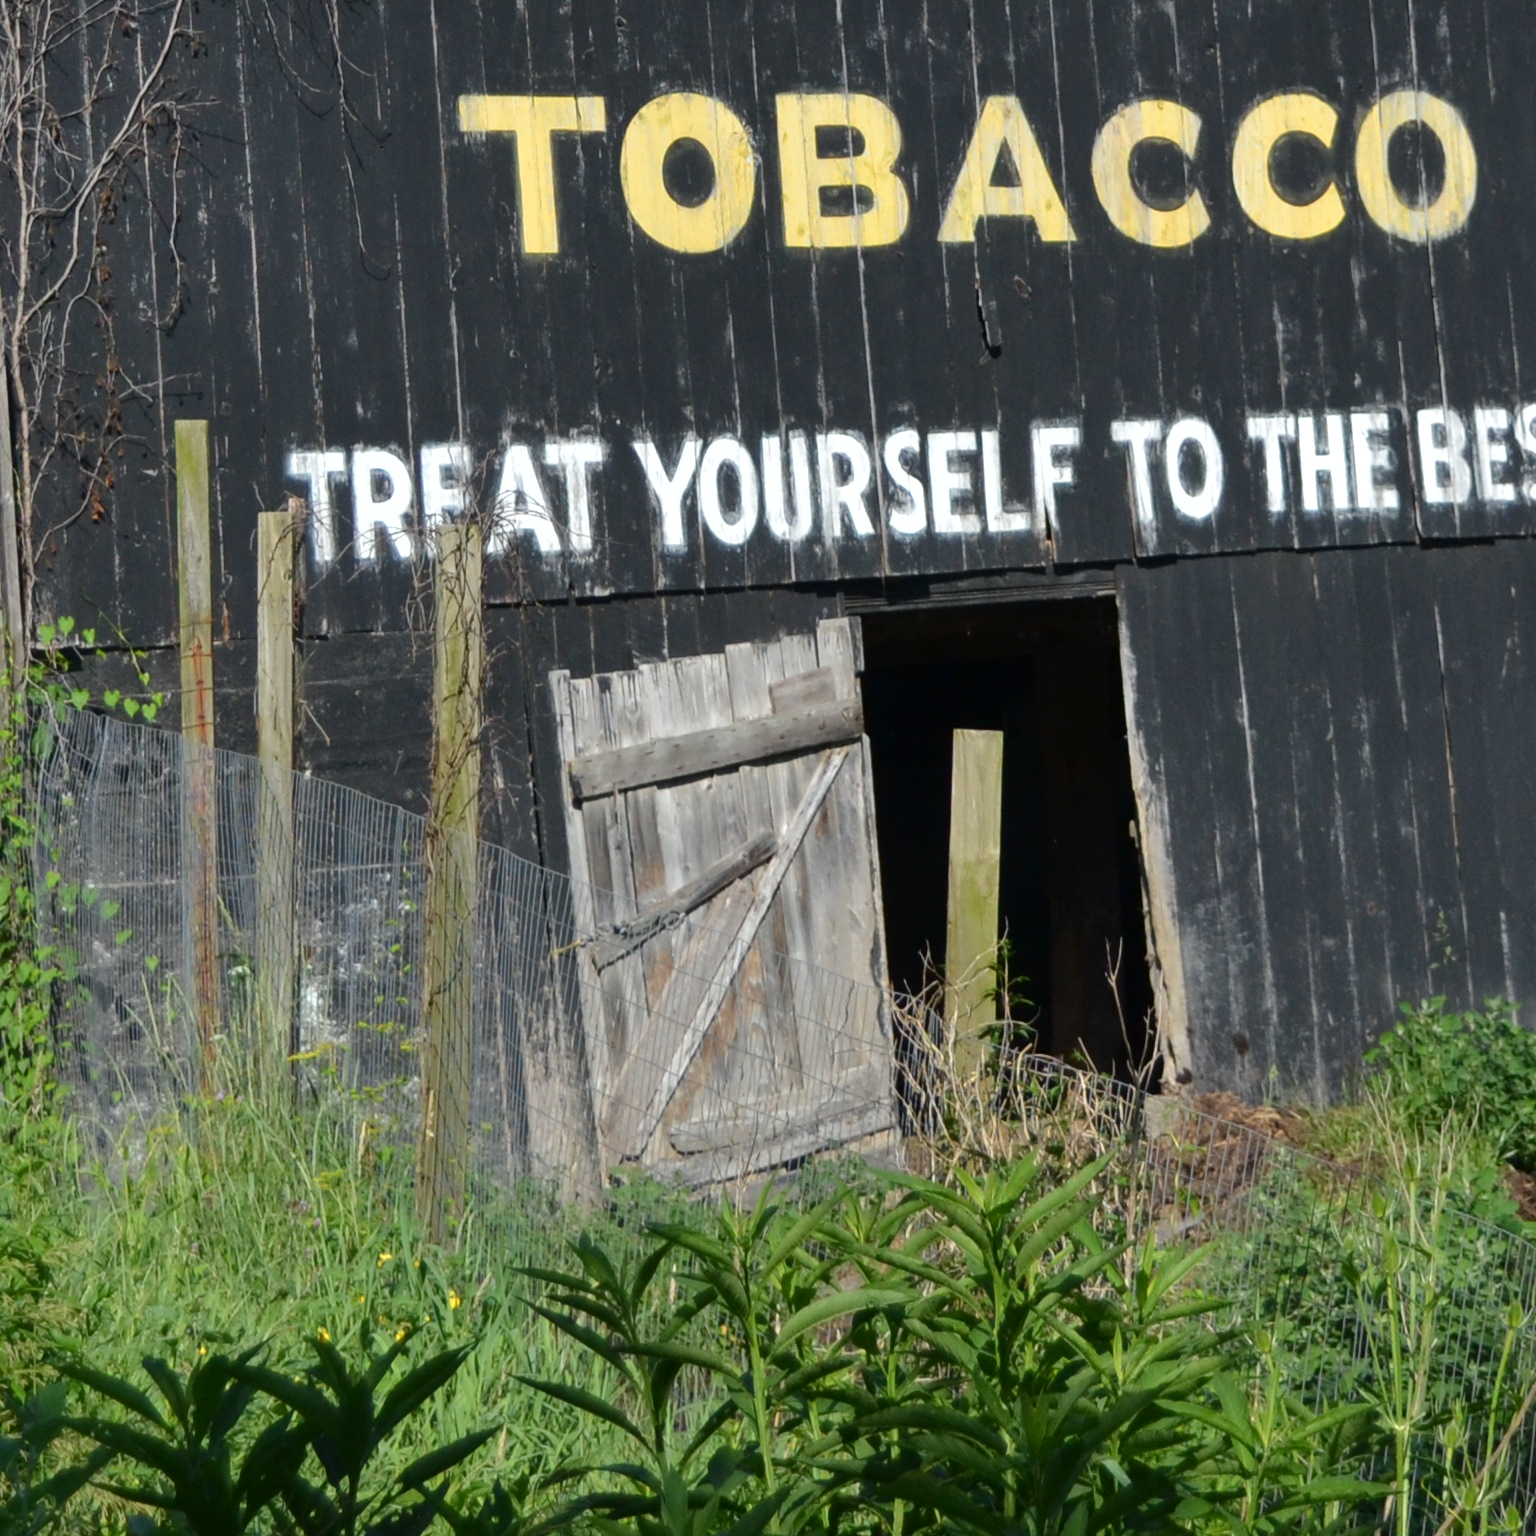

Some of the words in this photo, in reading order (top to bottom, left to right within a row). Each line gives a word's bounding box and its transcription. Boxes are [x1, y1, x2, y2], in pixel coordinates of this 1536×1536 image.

[459, 91, 1478, 255] TOBACCO
[289, 441, 604, 562] TREAT
[633, 420, 1080, 552] YOURSELF
[1111, 417, 1224, 550] TO
[1247, 408, 1400, 511] THE
